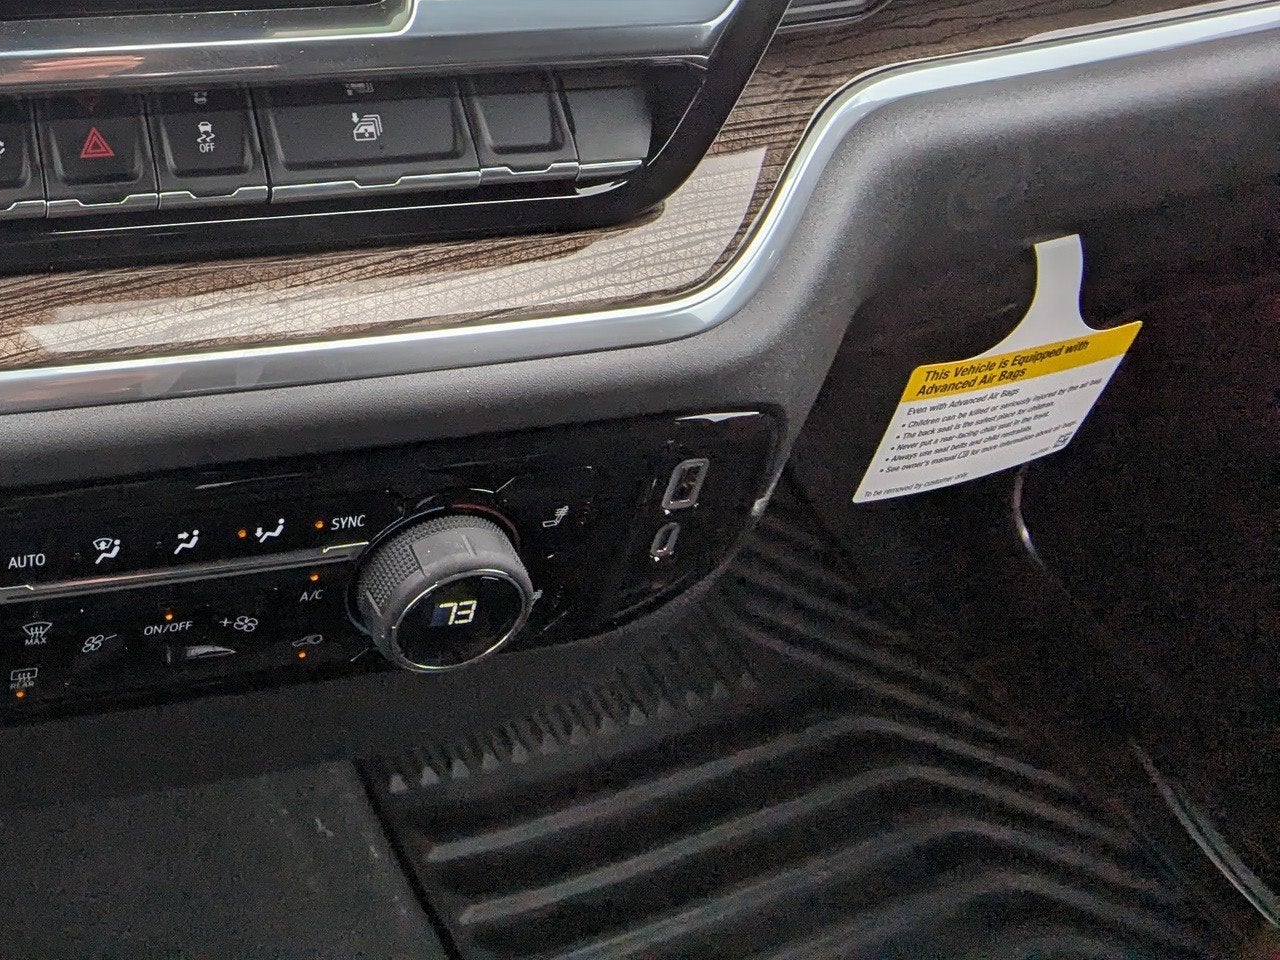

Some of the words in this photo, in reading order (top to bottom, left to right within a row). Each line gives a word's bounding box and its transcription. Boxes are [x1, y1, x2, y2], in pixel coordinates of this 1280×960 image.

[199, 142, 216, 153] OFF
[925, 369, 950, 382] This
[954, 361, 996, 377] Vehicle
[998, 358, 1009, 369] is
[1011, 346, 1063, 366] Equipped
[1065, 340, 1089, 354] with
[916, 376, 978, 396] Advanced
[977, 373, 996, 386] Air
[997, 368, 1027, 382] Bags
[907, 406, 927, 416] Even
[929, 402, 948, 412] with
[948, 394, 988, 408] Advanced
[987, 392, 1000, 401] Air
[1000, 388, 1020, 398] Bags
[331, 514, 366, 530] SYNC
[8, 553, 46, 570] AUTO
[300, 589, 324, 602] A/C
[439, 600, 478, 625] 73
[143, 621, 194, 636] ON/OFF
[24, 637, 47, 647] MAX
